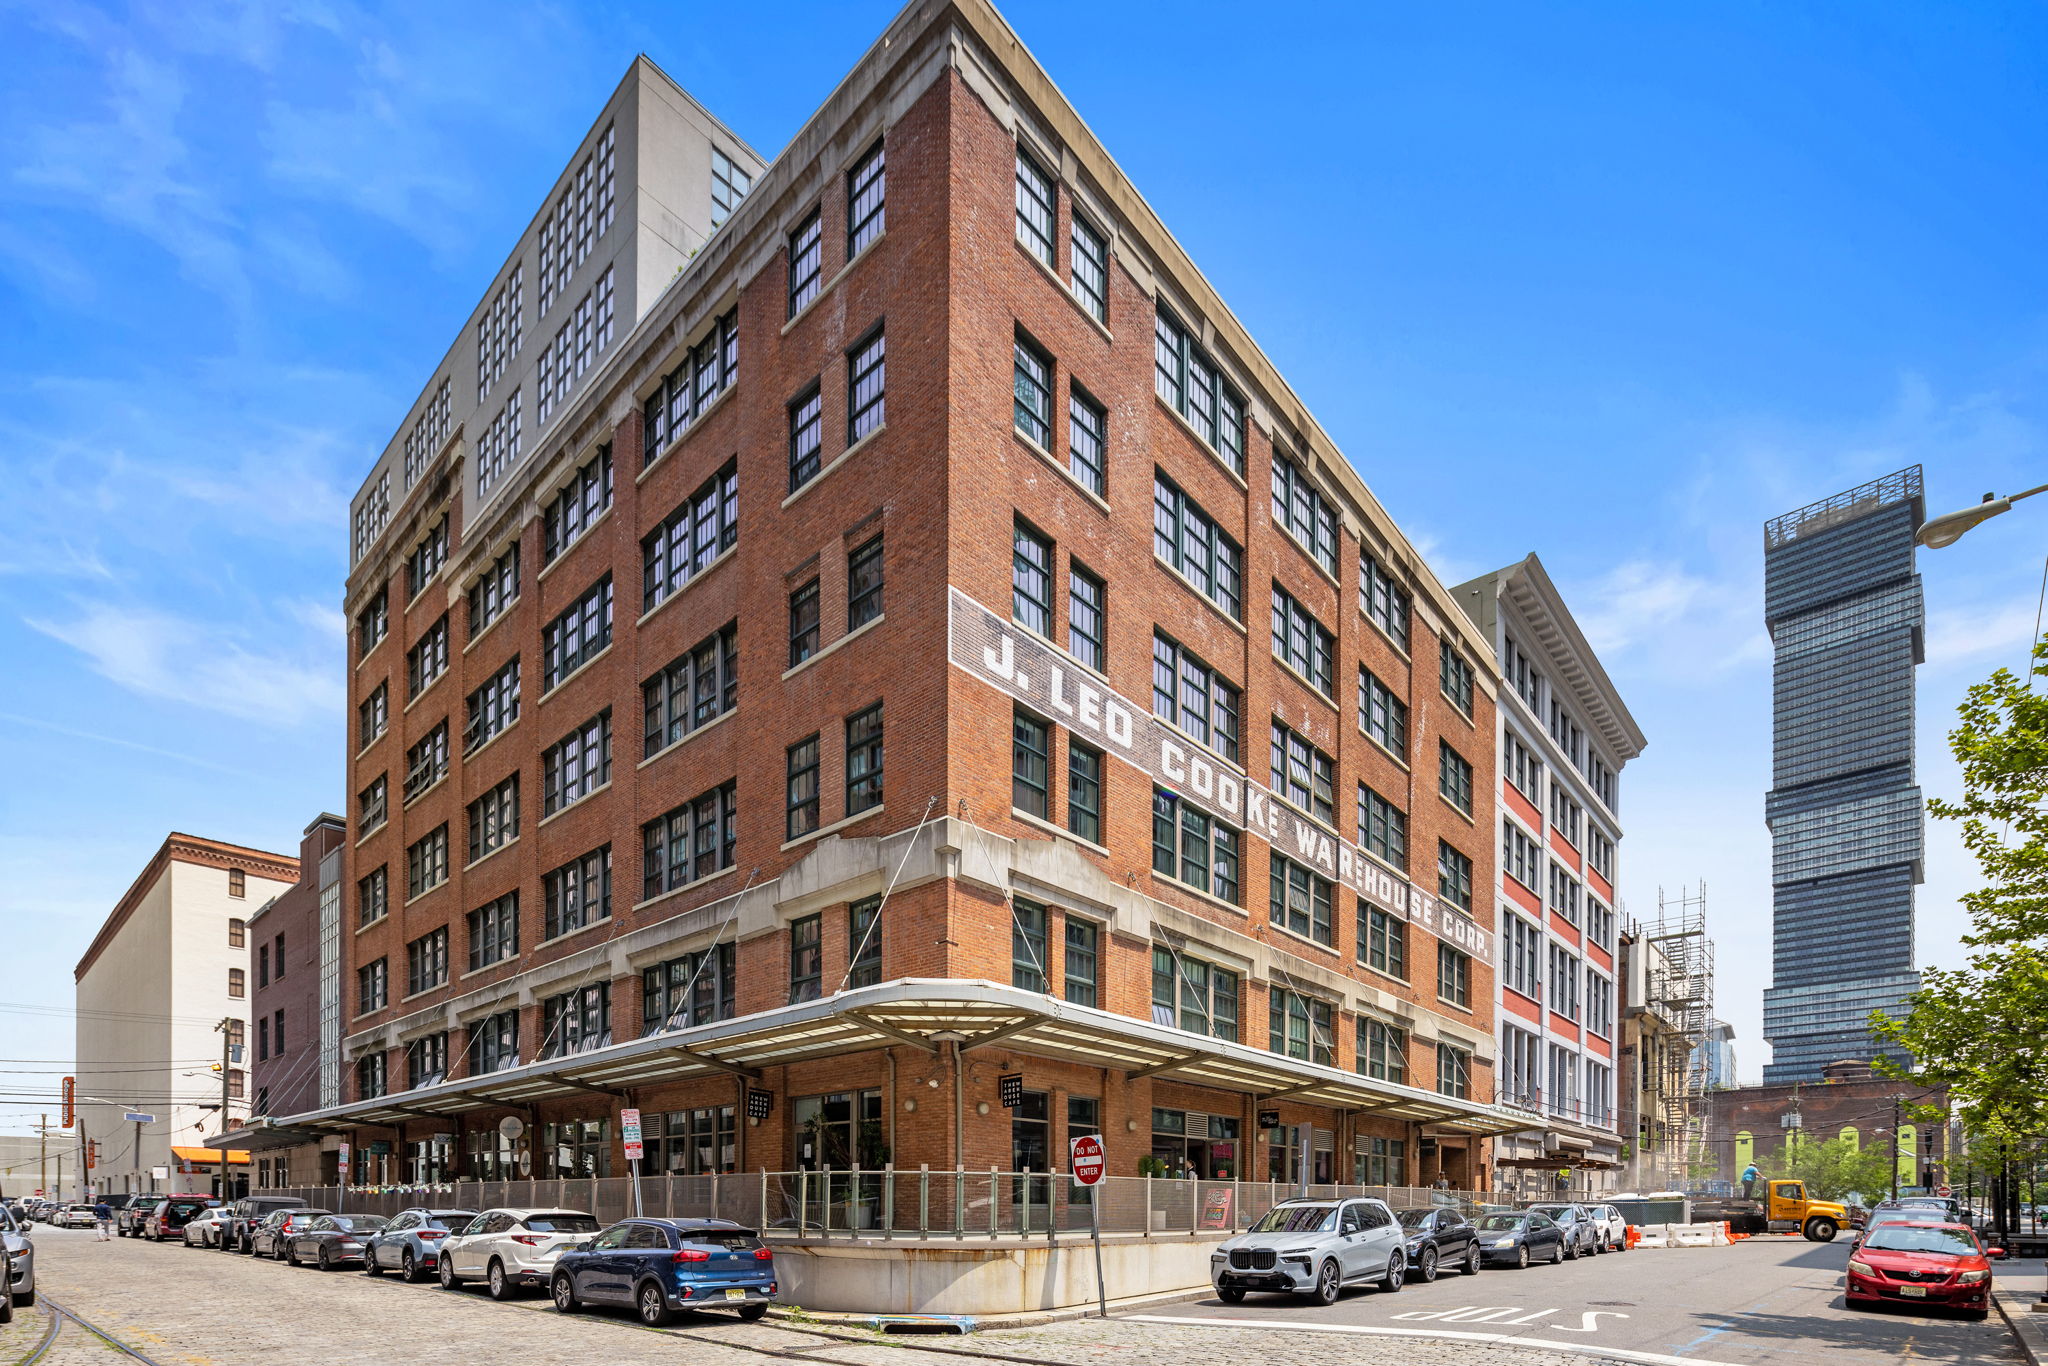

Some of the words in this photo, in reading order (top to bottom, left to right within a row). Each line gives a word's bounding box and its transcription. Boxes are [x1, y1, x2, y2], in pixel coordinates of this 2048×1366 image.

[984, 634, 1028, 691] J.
[1051, 664, 1133, 749] LEO
[1162, 739, 1279, 838] COOKE
[1295, 820, 1433, 925] WAREHOUSE
[1442, 911, 1488, 958] CORP.
[1076, 1147, 1085, 1155] DO
[1087, 1145, 1098, 1154] NOT
[1080, 1167, 1098, 1176] ENTER
[1389, 1306, 1631, 1332] STOP
